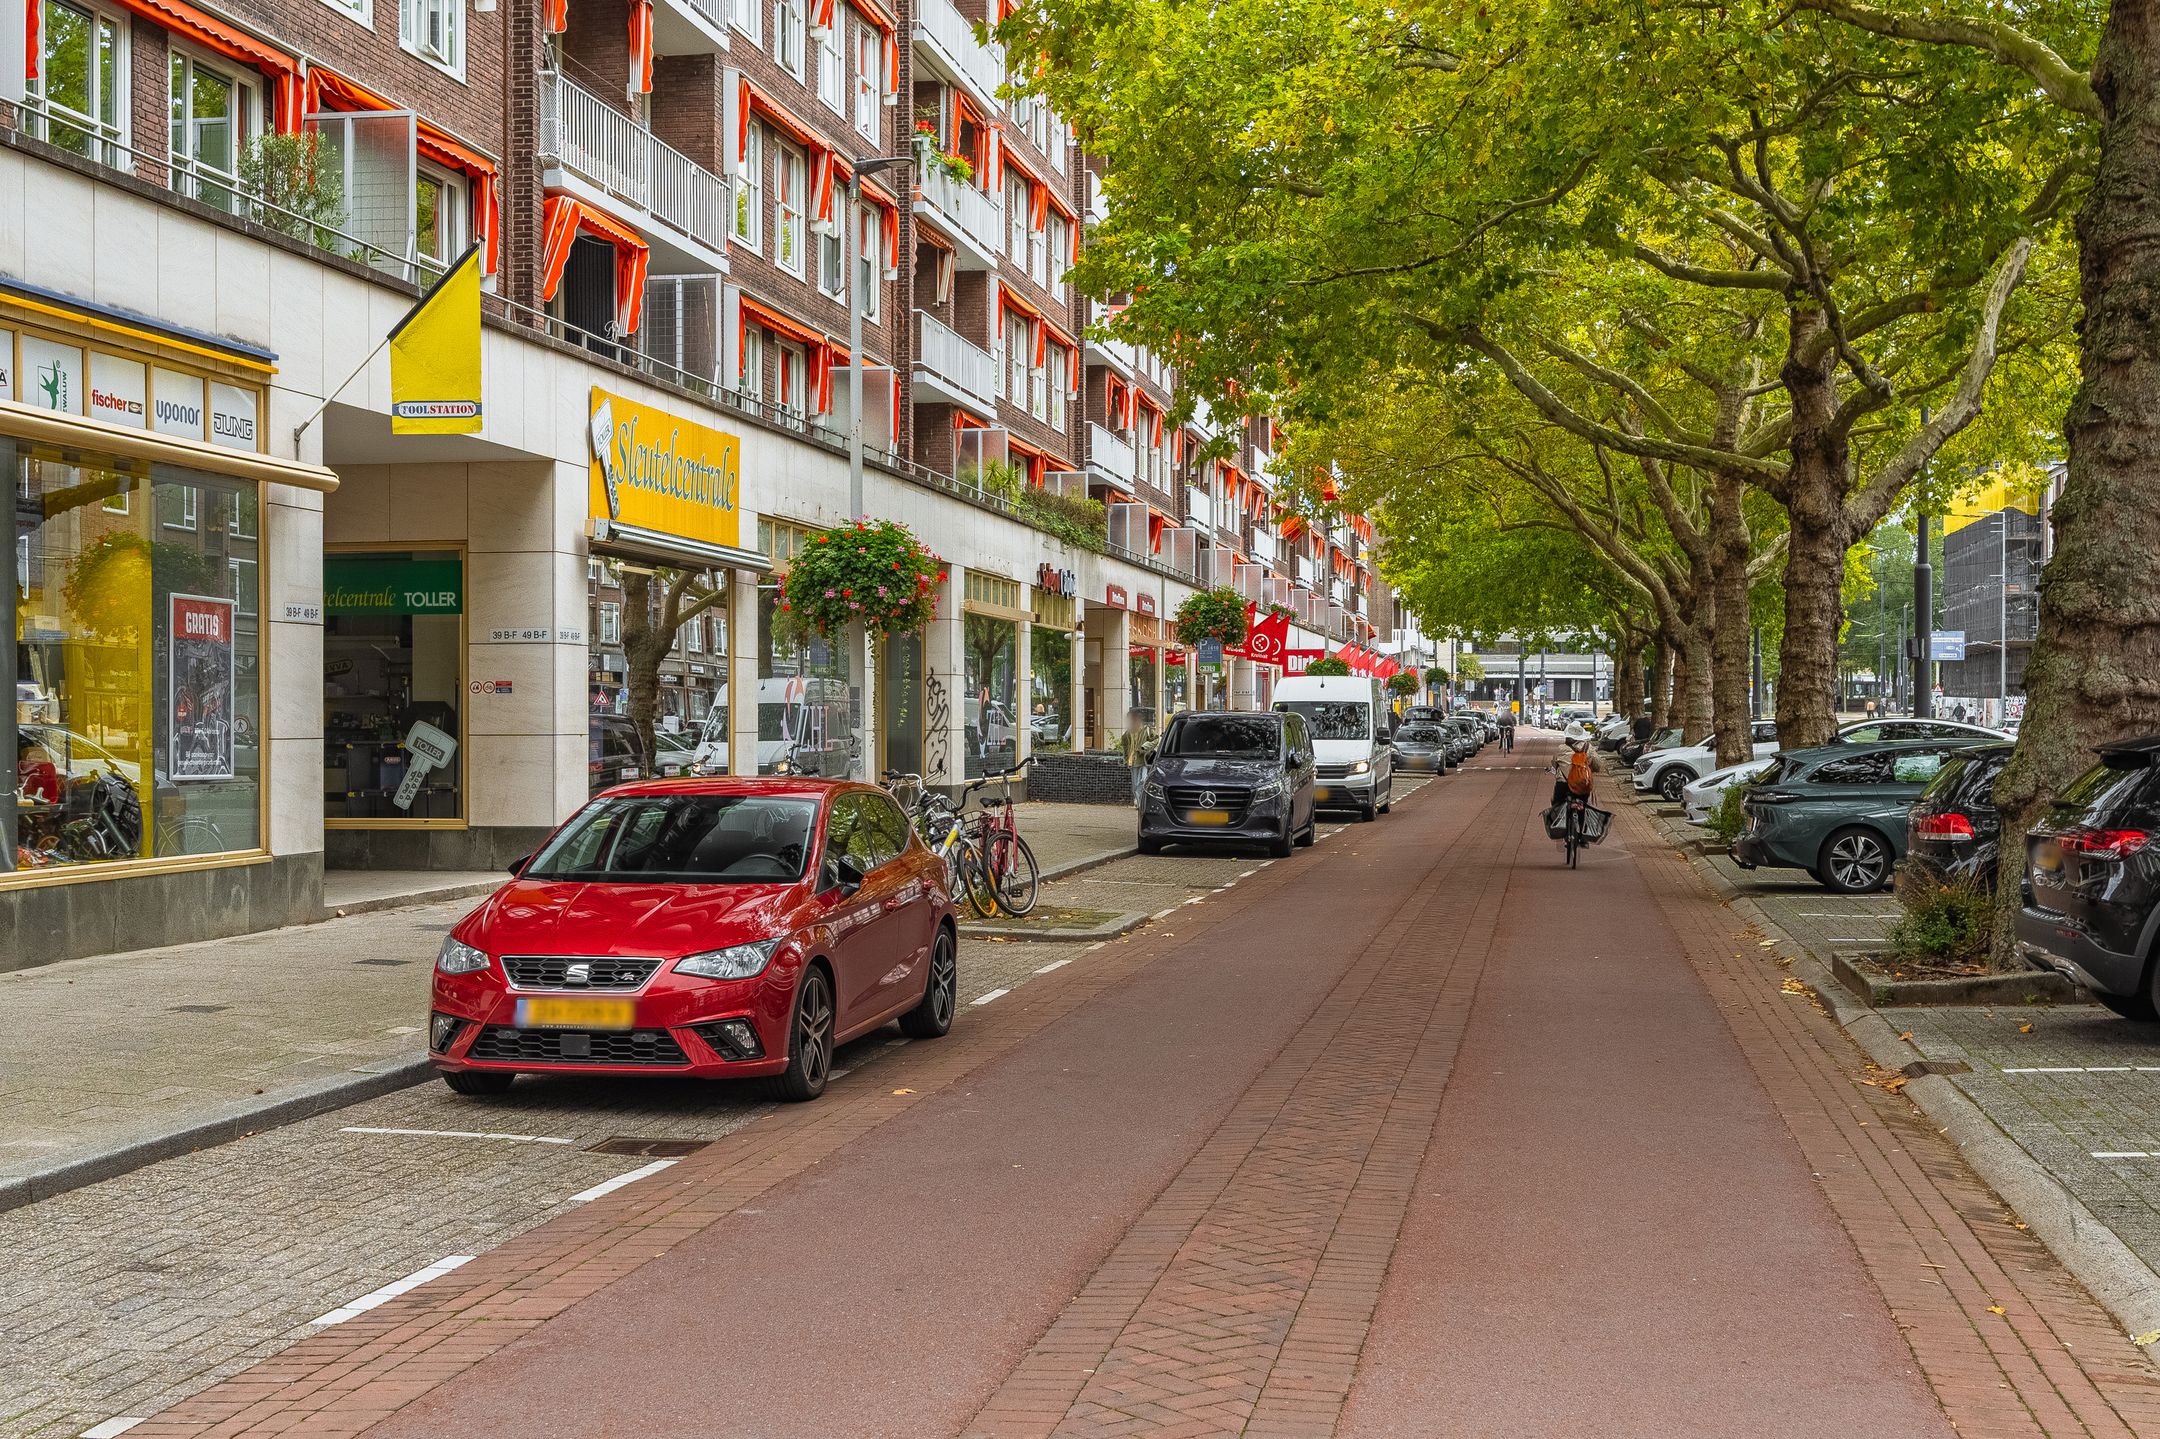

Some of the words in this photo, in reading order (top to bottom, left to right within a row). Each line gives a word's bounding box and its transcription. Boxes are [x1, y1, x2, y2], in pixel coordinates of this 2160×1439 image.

[91, 388, 128, 412] fischer
[401, 404, 475, 415] TOOLSTATION
[155, 399, 201, 426] uponor
[213, 412, 253, 441] JUNG
[615, 414, 736, 512] Sleutelcentrale
[403, 591, 457, 608] TOLLER
[185, 611, 220, 637] GRATIS
[492, 630, 503, 640] 39
[503, 630, 518, 640] B-F
[522, 630, 532, 640] 49
[533, 630, 548, 639] B-F
[415, 737, 443, 761] TOLLER
